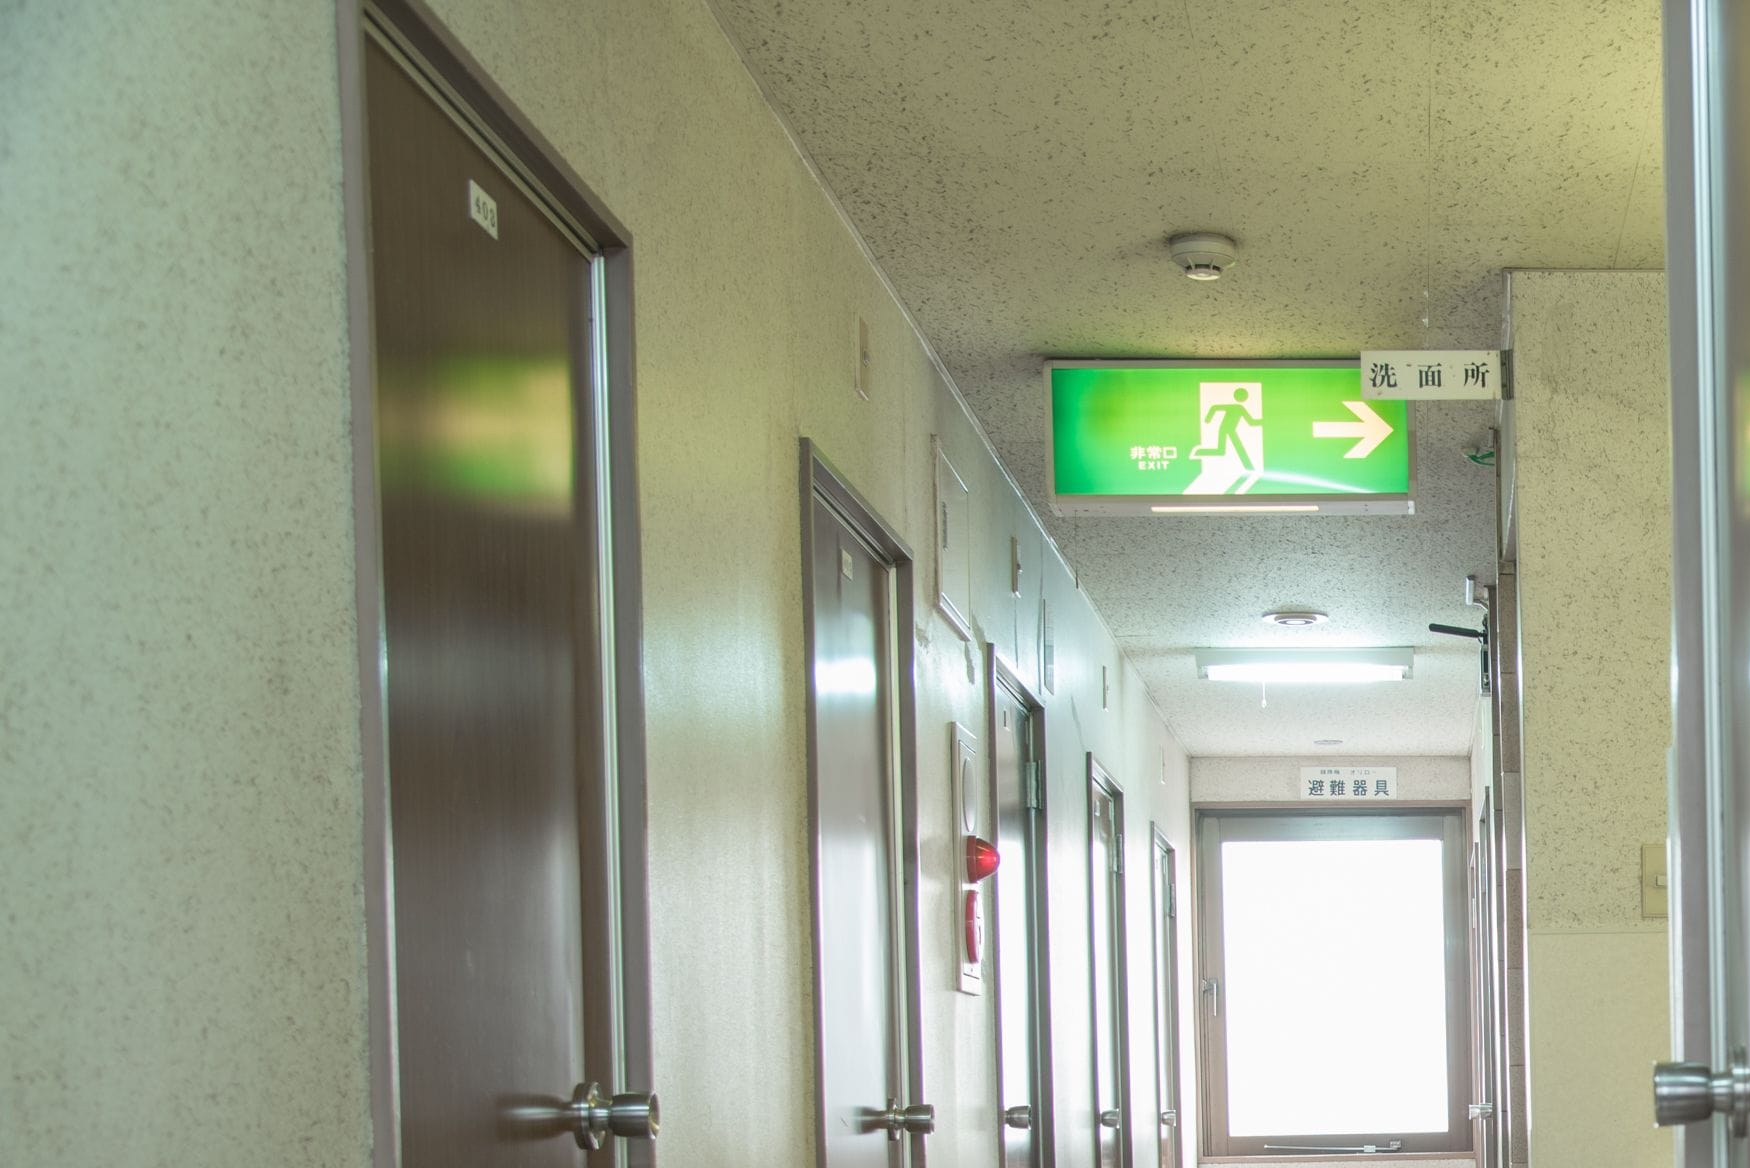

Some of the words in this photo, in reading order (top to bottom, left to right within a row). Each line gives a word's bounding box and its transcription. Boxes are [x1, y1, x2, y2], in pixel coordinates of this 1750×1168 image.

[1369, 362, 1490, 388] 洗面所
[1130, 446, 1177, 459] 非常口
[1138, 460, 1169, 470] EXIT
[1308, 779, 1389, 796] 避難器具
